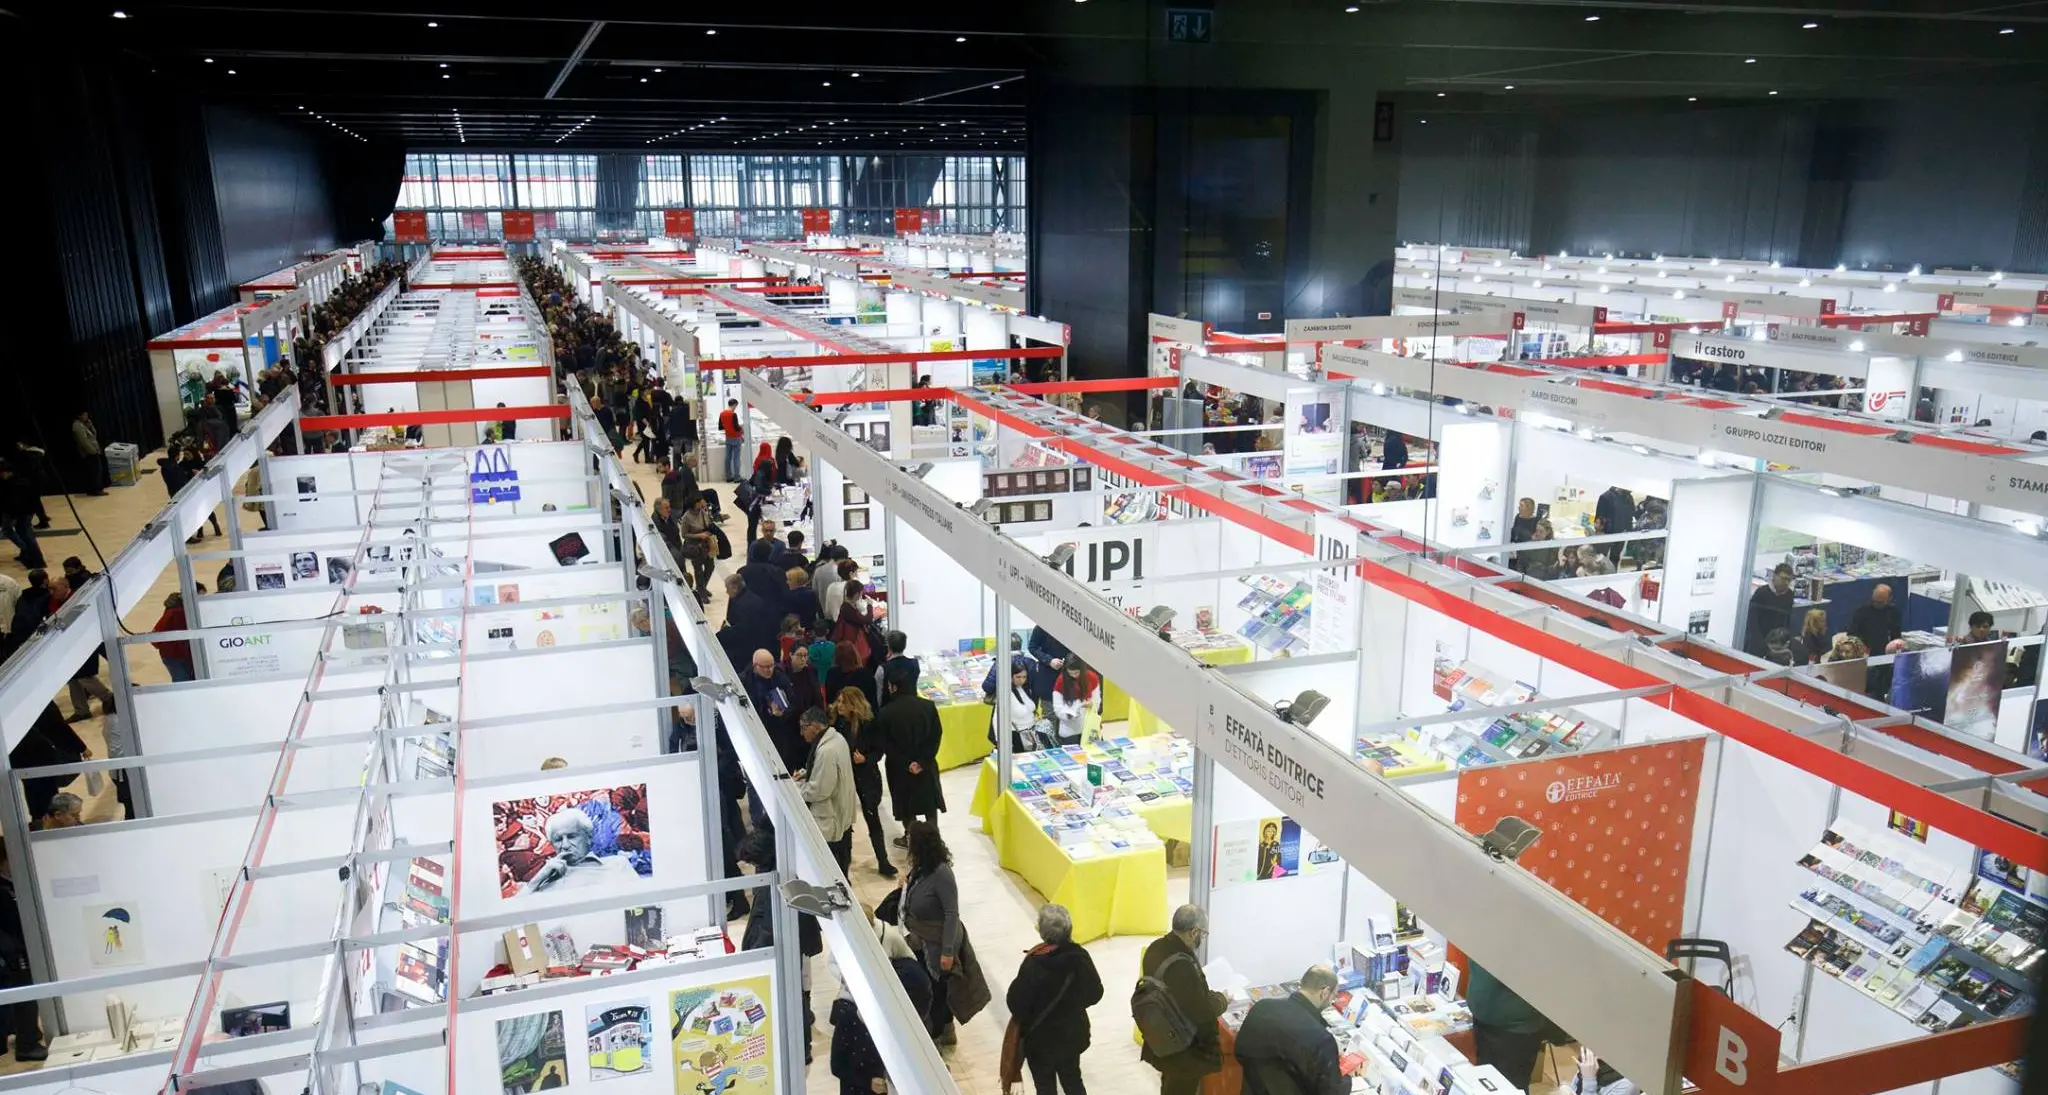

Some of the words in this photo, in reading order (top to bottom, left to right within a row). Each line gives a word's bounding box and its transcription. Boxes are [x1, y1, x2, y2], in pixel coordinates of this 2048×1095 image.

[1944, 299, 1950, 307] F
[1517, 316, 1522, 326] D
[1914, 320, 1920, 330] E
[1658, 332, 1664, 343] D
[1694, 341, 1701, 354] il
[1704, 343, 1746, 360] castoro
[1987, 352, 2019, 362] EDITRICE
[1171, 353, 1177, 364] C
[1550, 393, 1578, 406] EDIZIONI
[1725, 425, 1761, 440] GRUPPO
[1762, 433, 1787, 446] LOZZI
[1789, 438, 1826, 453] EDITORI
[1319, 533, 1349, 582] UPI
[1010, 564, 1020, 581] UPI
[1025, 574, 1061, 612] UNIVERSITY
[1061, 601, 1082, 626] PRESS
[1083, 615, 1116, 651] ITALIANE
[219, 634, 272, 649] GIOANT
[1226, 714, 1265, 757] EFFATÀ
[1267, 743, 1324, 799] EDITRICE
[1269, 771, 1304, 808] EDITORI
[1564, 790, 1598, 802] EDITRICE
[1715, 1024, 1748, 1086] B
